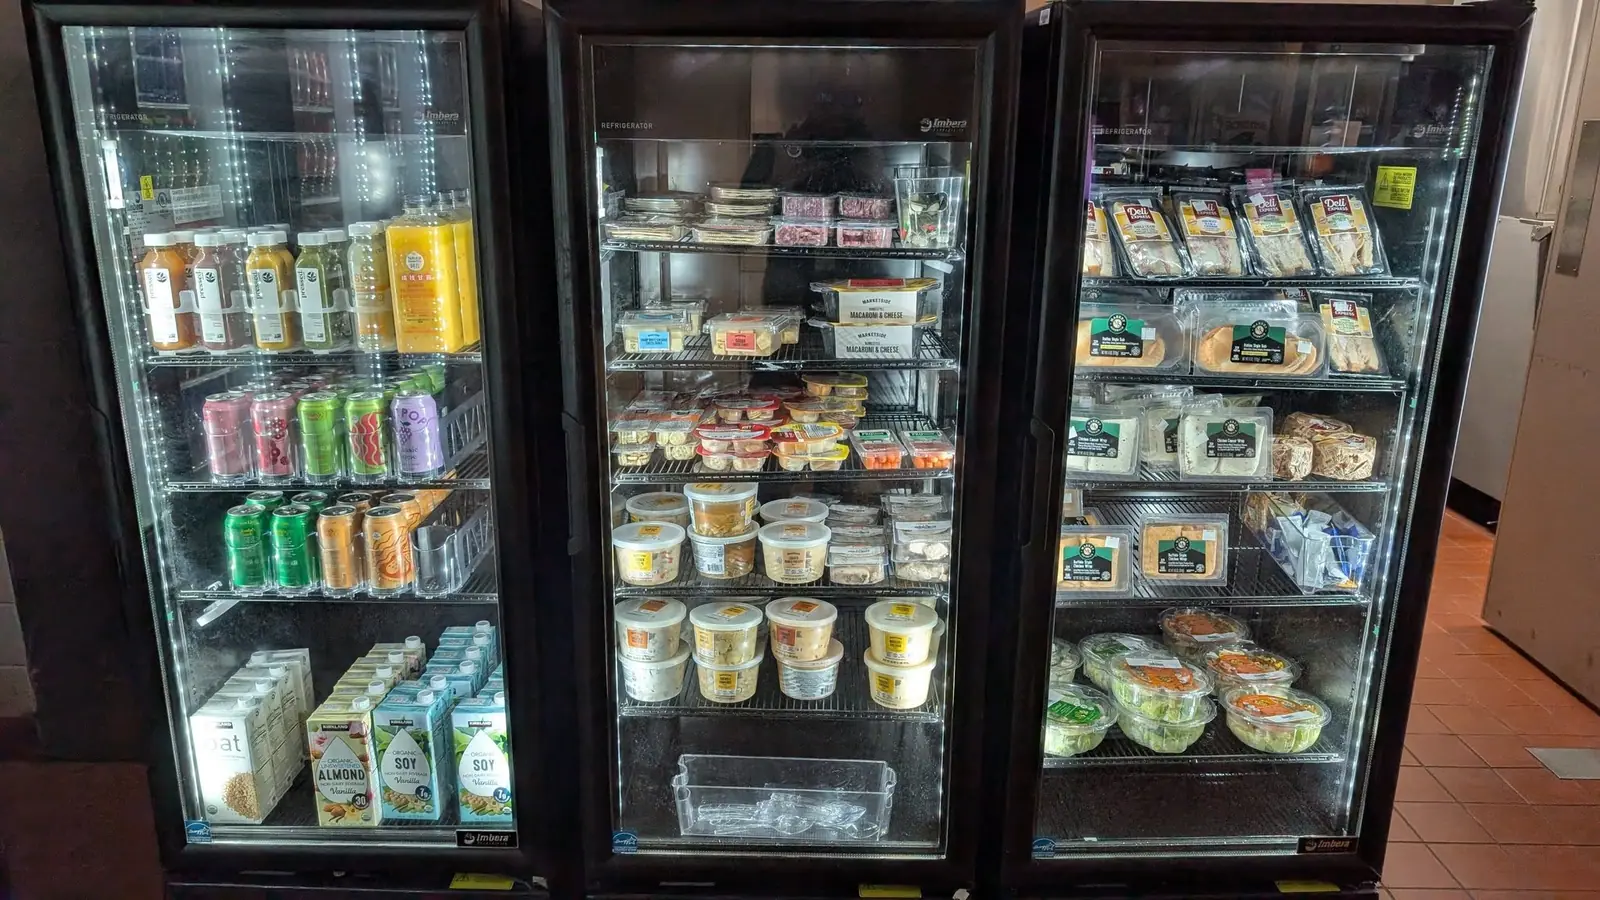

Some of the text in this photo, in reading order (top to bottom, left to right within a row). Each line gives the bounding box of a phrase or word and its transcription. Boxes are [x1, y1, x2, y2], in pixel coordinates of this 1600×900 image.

[932, 118, 967, 128] Imbera
[1101, 127, 1152, 135] REFRIGERATOR
[1325, 198, 1347, 208] Deli
[1127, 206, 1149, 215] Deli
[297, 271, 307, 299] pressed
[884, 311, 903, 319] CHEESE
[880, 346, 900, 354] CHEESE
[401, 408, 427, 424] POP
[394, 757, 417, 770] SOY
[473, 759, 495, 771] SOY
[318, 769, 366, 781] ALMOND
[394, 776, 420, 784] Vanilla
[329, 787, 357, 795] Vanilla
[355, 797, 366, 806] 30
[476, 833, 509, 842] Imbera
[1318, 839, 1350, 848] Imbera
